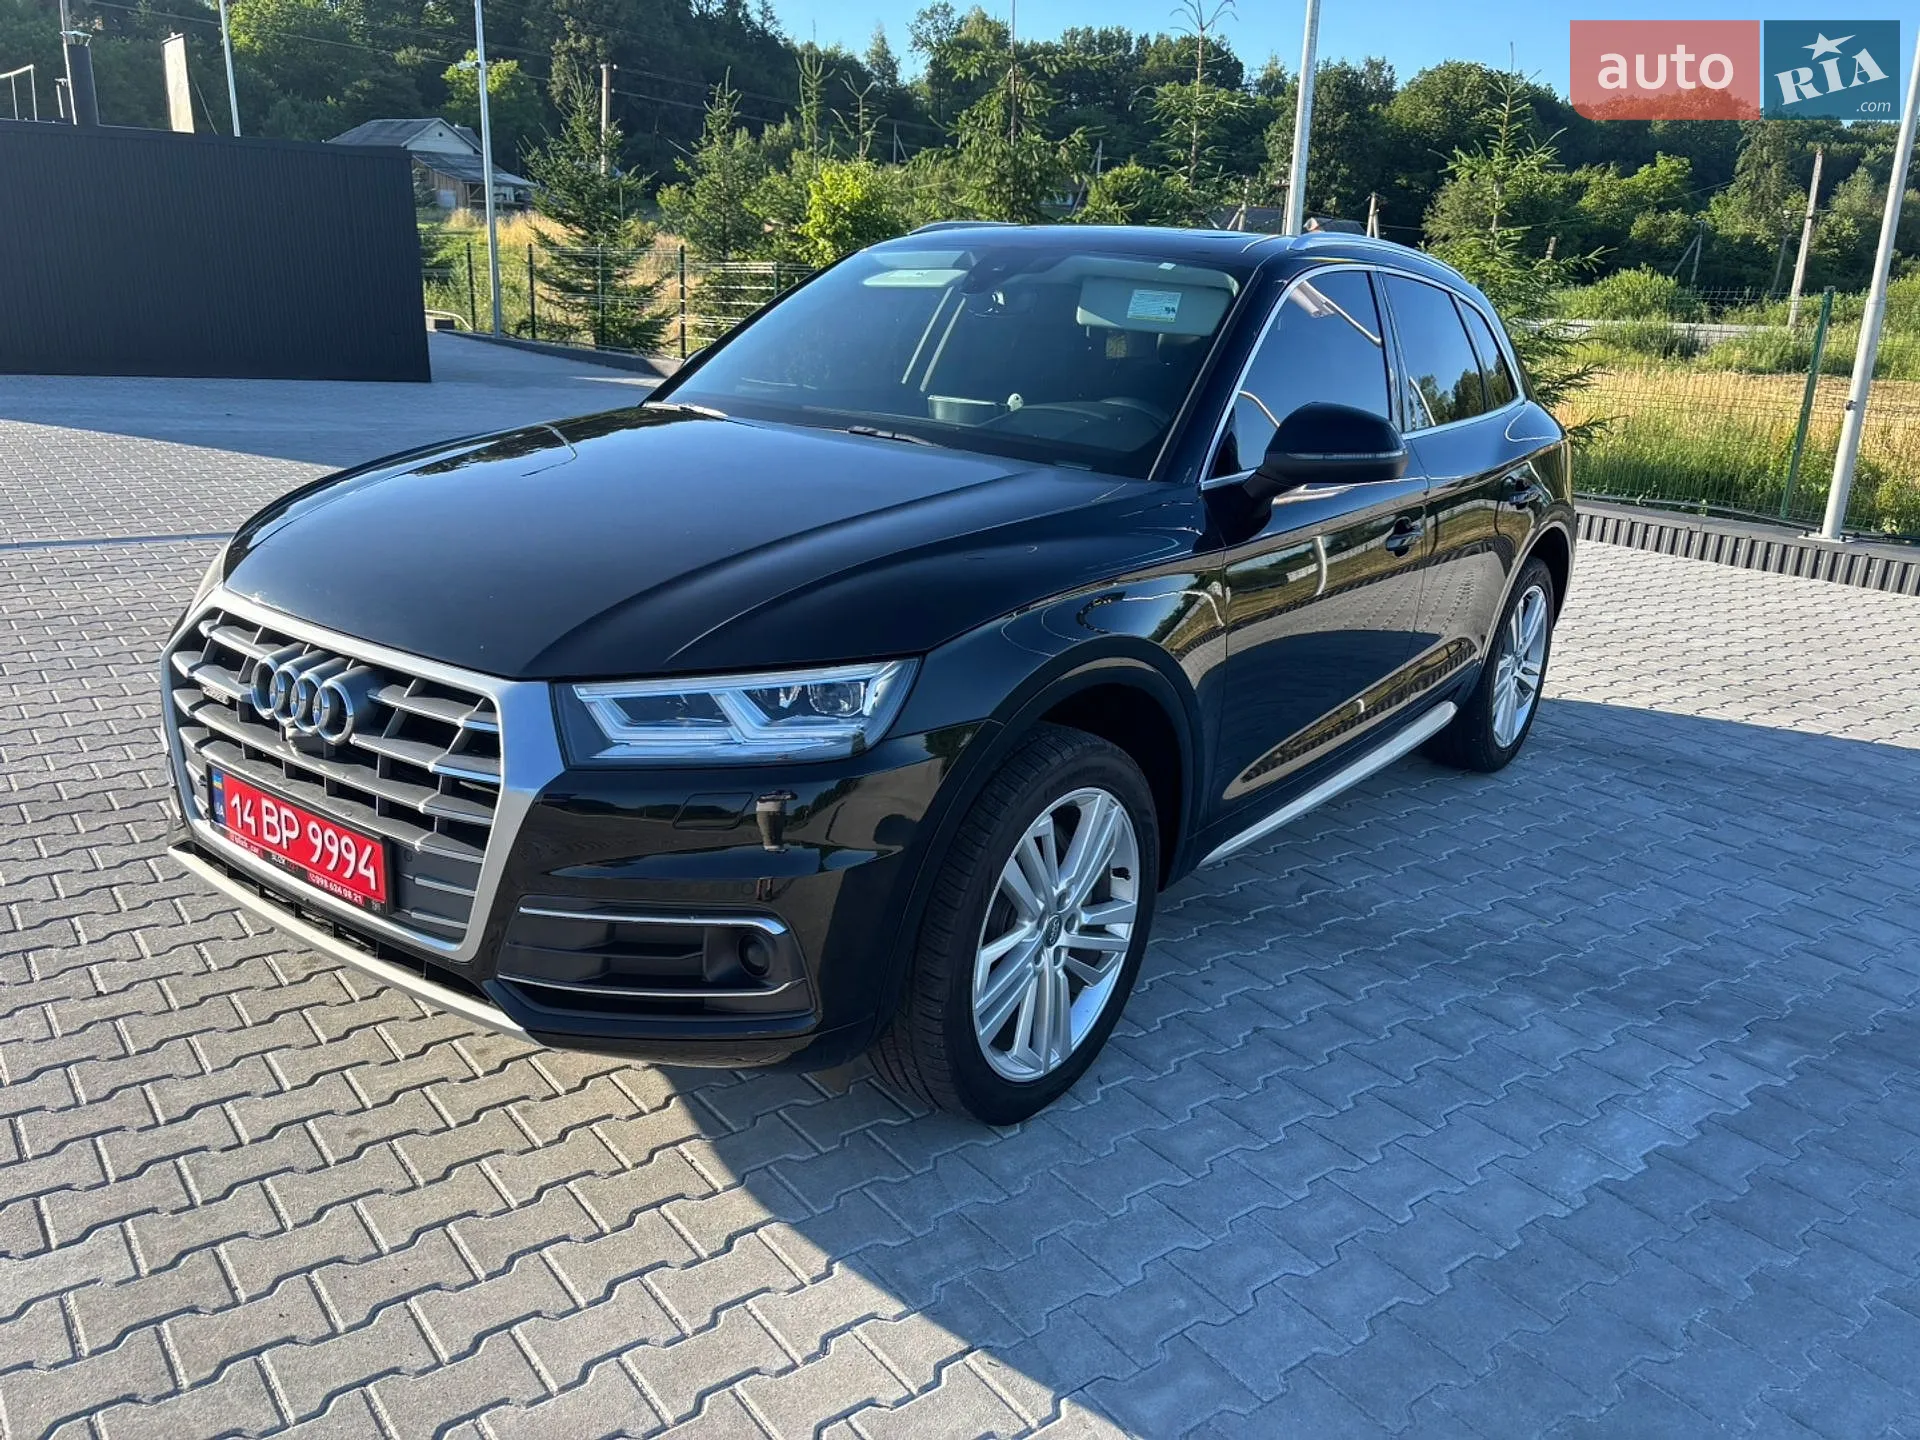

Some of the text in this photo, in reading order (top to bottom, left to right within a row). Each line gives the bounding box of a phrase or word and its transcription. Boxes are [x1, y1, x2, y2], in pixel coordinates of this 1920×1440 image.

[231, 793, 377, 891] 14 BP 9994
